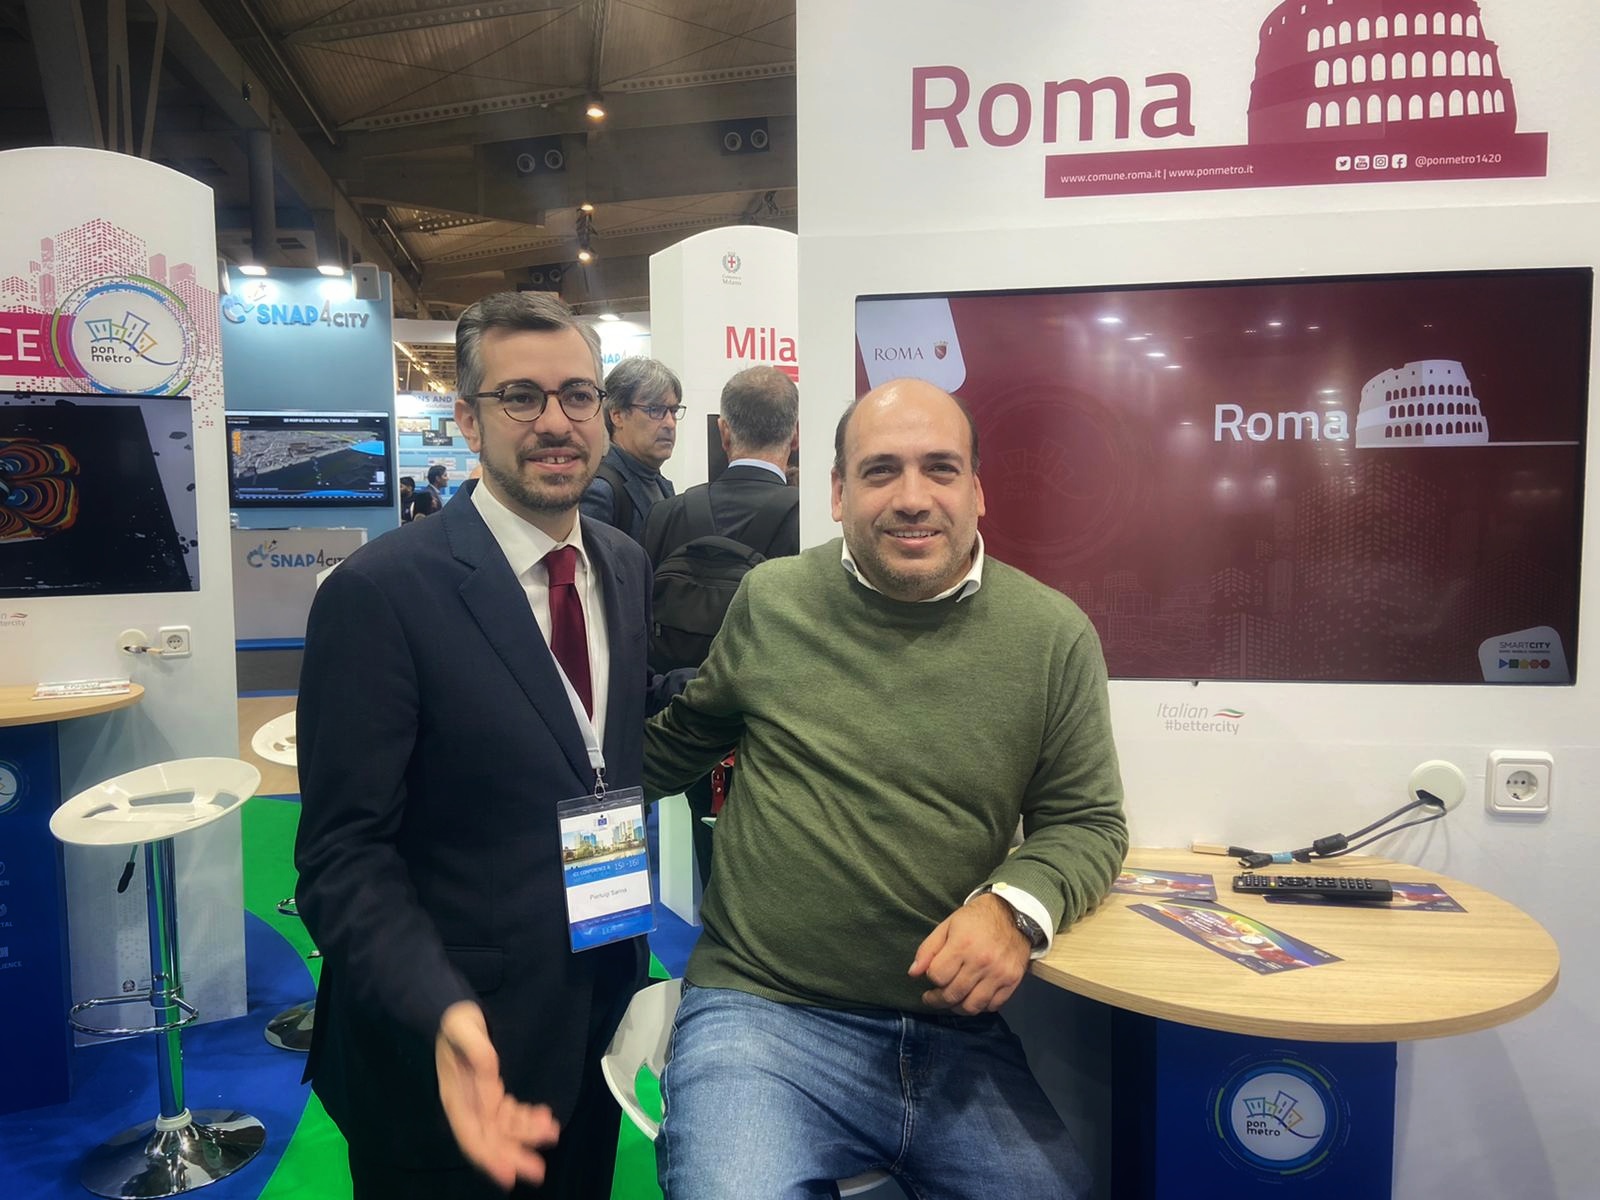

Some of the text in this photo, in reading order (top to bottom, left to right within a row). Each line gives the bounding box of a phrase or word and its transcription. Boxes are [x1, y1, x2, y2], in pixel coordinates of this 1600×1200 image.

[911, 65, 1196, 151] Roma
[1415, 153, 1502, 168] @ponmetro1420
[1060, 169, 1161, 184] www.comune.roma.it
[1168, 164, 1254, 179] www.ponmetro.it
[90, 345, 115, 355] pon
[874, 346, 924, 361] ROMA
[91, 354, 132, 364] metro
[1214, 403, 1350, 442] Roma
[1499, 641, 1552, 650] SMARTCITY
[1156, 702, 1209, 719] Italian
[1165, 719, 1240, 736] #bettercity
[1246, 1120, 1267, 1129] pon
[1246, 1127, 1281, 1137] metro
